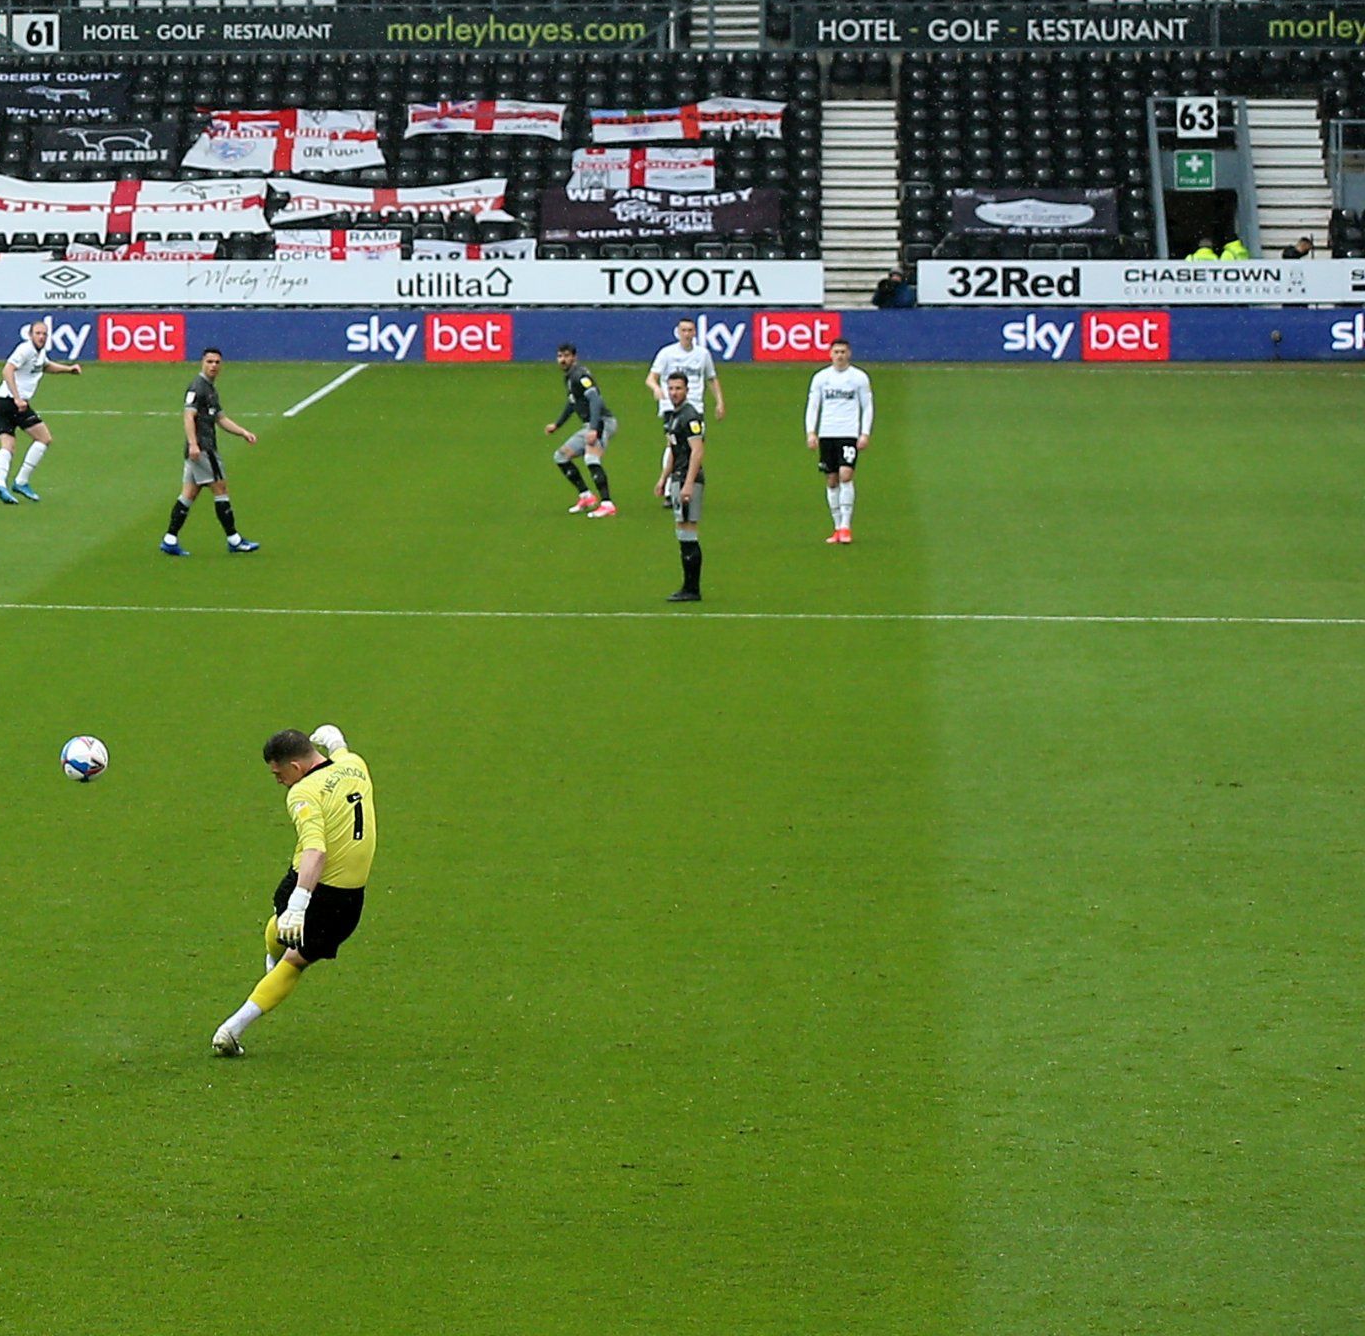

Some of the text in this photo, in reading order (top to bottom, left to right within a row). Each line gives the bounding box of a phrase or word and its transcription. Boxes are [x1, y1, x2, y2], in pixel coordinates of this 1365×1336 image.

[26, 20, 55, 47] 61
[83, 23, 332, 41] HOTEL GOLF RESTAURANT
[387, 15, 646, 48] morleyhayes.com
[818, 18, 1189, 43] HOTEL GOLF RESTAURANT
[56, 72, 122, 83] COUNTY
[1180, 104, 1215, 131] 63
[41, 150, 68, 163] WE
[72, 150, 107, 163] ARE
[567, 187, 754, 207] WE ARE DERBY
[349, 231, 400, 243] RAMS
[279, 250, 326, 262] DCFC
[201, 265, 310, 290] Morley Hayes
[397, 270, 482, 298] utilita
[601, 268, 761, 297] TOYOTA
[948, 266, 1081, 298] 32Red
[1124, 268, 1281, 282] CHASETOWN
[44, 290, 87, 301] umbro
[1124, 286, 1281, 295] CIVIL ENGINEERING
[106, 318, 176, 352] bet
[346, 316, 501, 360] sky bet
[674, 314, 830, 360] ky bet
[1003, 314, 1159, 360] sky bet
[323, 767, 367, 794] WESTWOOD
[347, 791, 364, 841] 1
